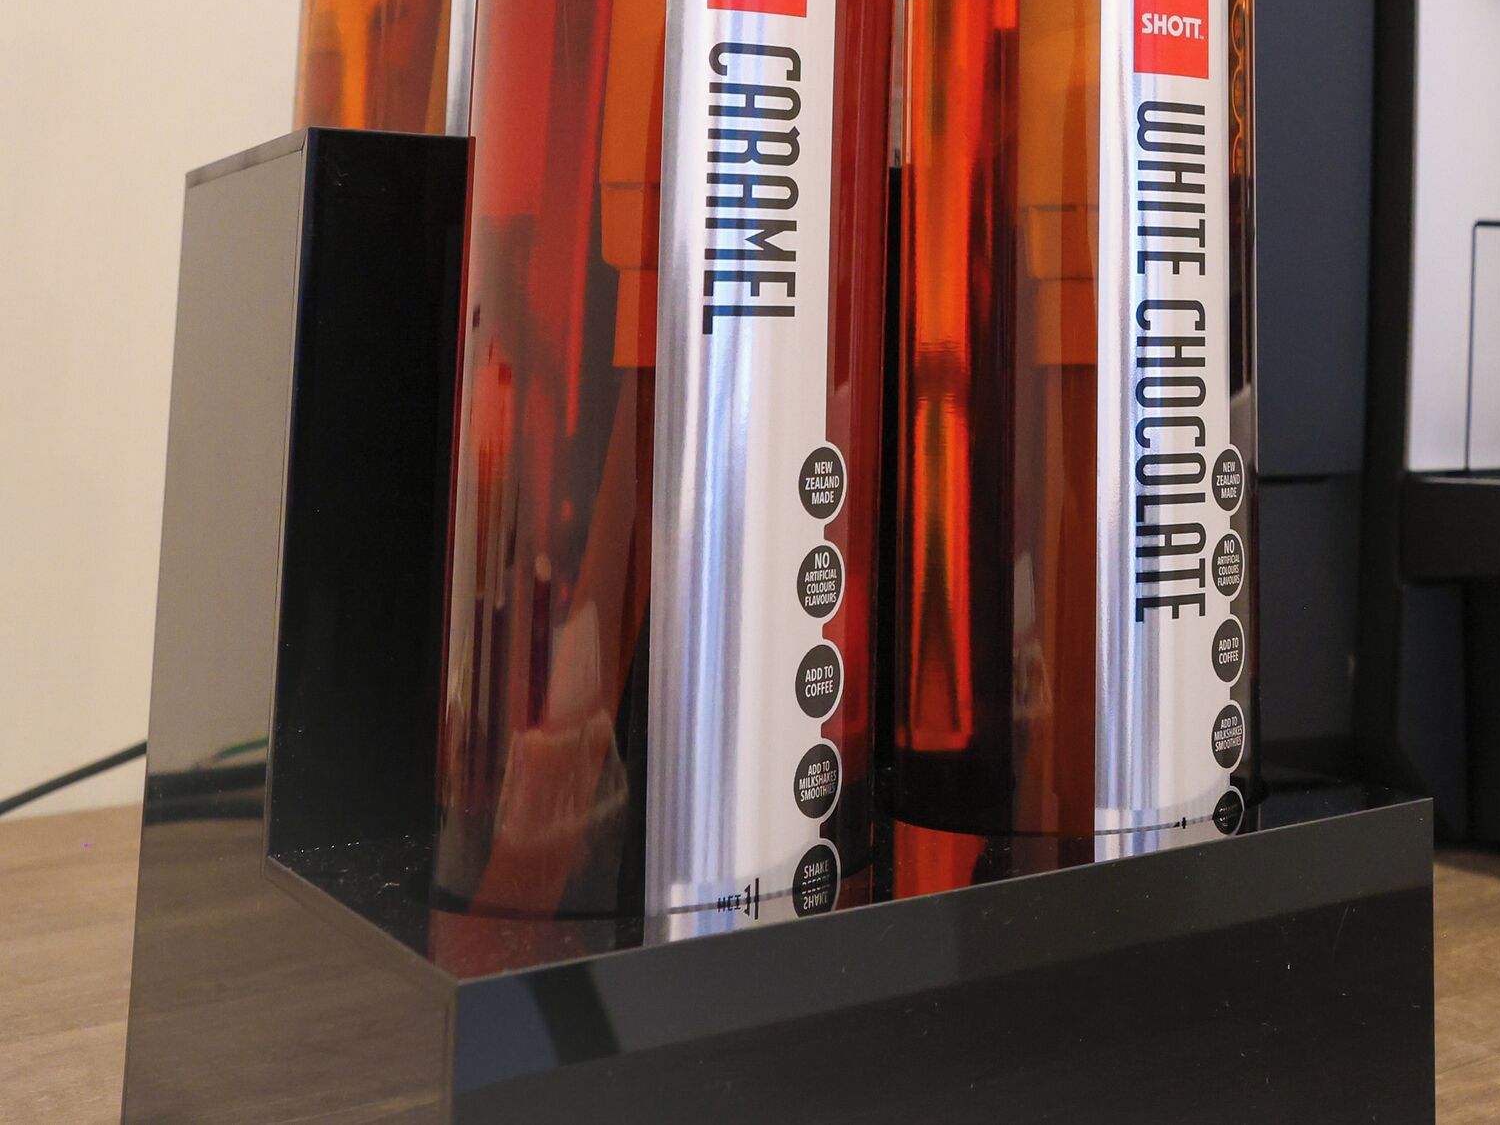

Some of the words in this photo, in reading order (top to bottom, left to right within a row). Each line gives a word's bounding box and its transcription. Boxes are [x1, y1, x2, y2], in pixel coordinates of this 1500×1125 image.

[1141, 12, 1203, 39] SHOTT
[702, 41, 802, 335] CARAMEL
[1137, 101, 1206, 275] WHITE
[814, 461, 834, 475] NEW
[1135, 299, 1206, 623] CHOCOLATE
[1222, 461, 1236, 474] NEW
[805, 476, 840, 490] ZEALAND
[1216, 474, 1241, 487] ZEALAND
[811, 491, 834, 505] MADE
[1220, 486, 1237, 499] MADE
[1223, 539, 1235, 555] NO
[814, 552, 829, 569] NO
[1217, 554, 1241, 566] ARTIFICIAL
[804, 568, 837, 583] ARTIFICIAL
[1218, 564, 1240, 576] COLOURS
[806, 580, 836, 595] COLOURS
[1217, 574, 1240, 587] FLAVOURS
[804, 592, 837, 607] FLAVOURS
[1218, 639, 1232, 652] ADD
[1232, 637, 1239, 650] TO
[1218, 650, 1239, 665] COFFEE
[805, 667, 823, 683] ADD
[824, 665, 834, 678] TO
[805, 679, 834, 698] COFFEE
[1220, 717, 1231, 729] ADD
[1231, 716, 1238, 727] TO
[1214, 726, 1243, 742] MILKSHAKES
[1215, 735, 1242, 752] SMOOTHIES
[808, 763, 822, 776] ADD
[822, 760, 830, 772] TO
[799, 769, 837, 790] MILKSHAKES
